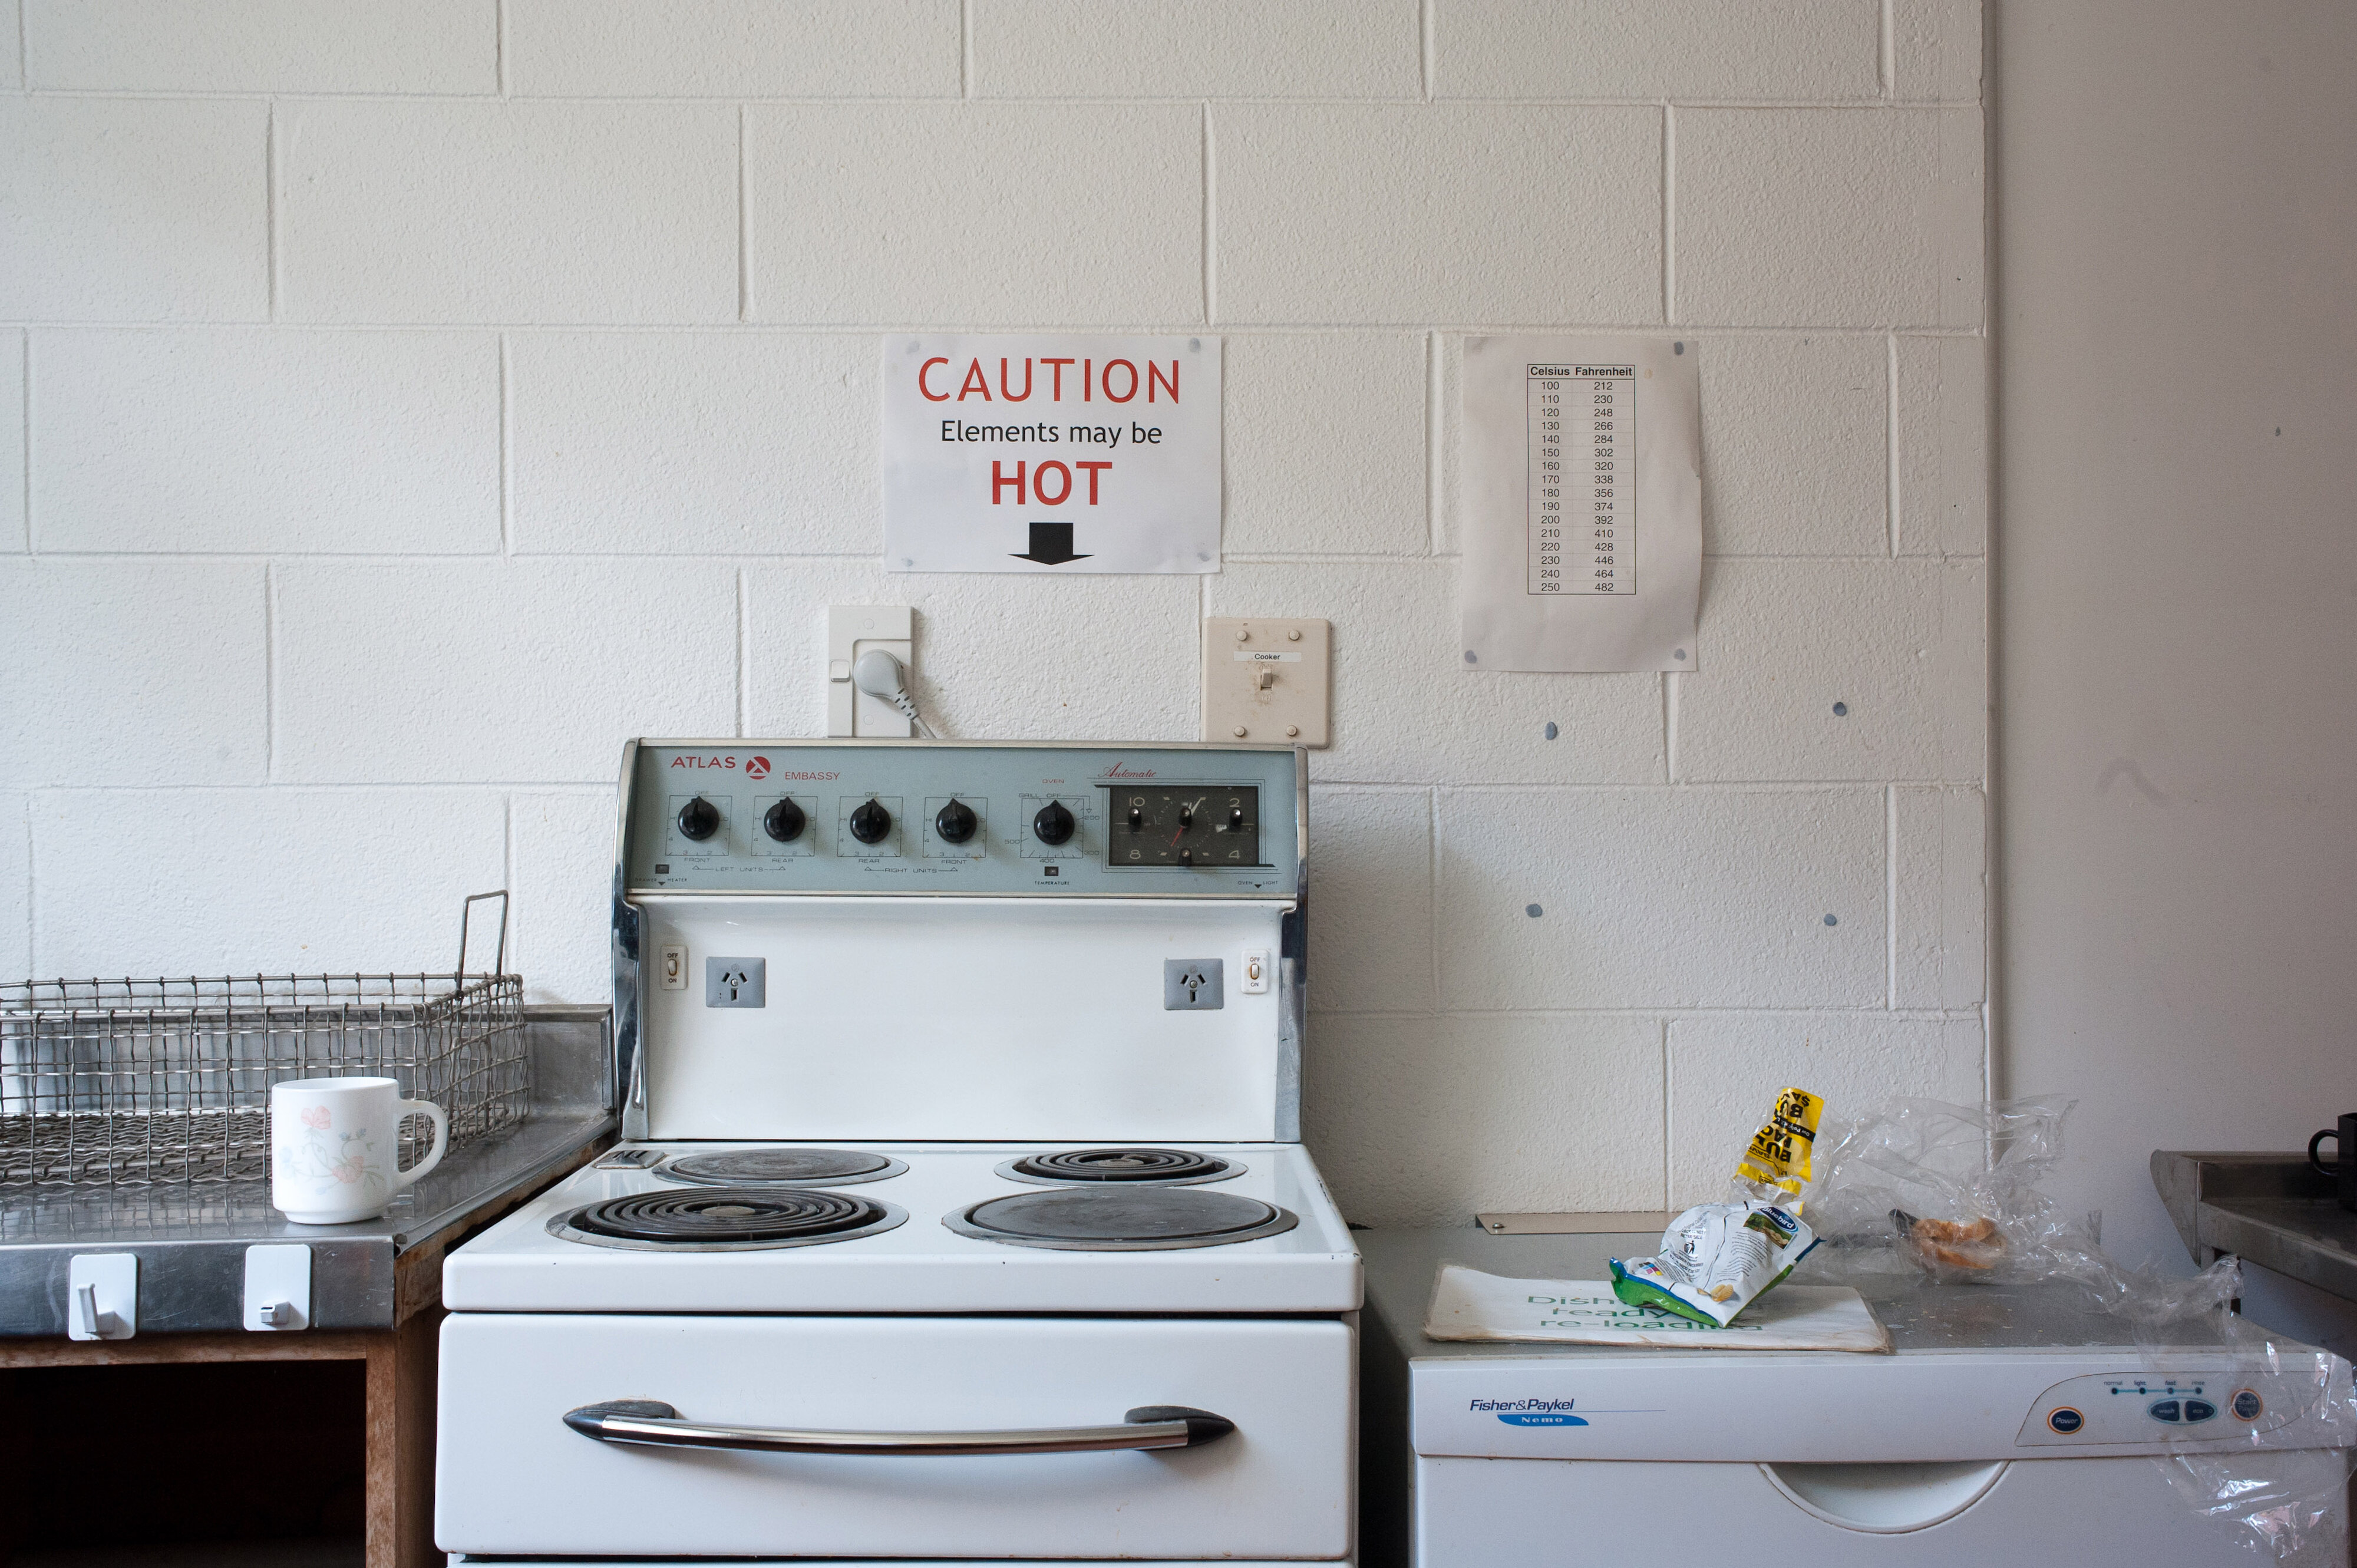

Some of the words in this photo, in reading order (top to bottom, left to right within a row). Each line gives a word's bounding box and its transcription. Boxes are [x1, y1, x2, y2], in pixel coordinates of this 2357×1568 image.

[1530, 367, 1570, 376] Celsius
[1575, 367, 1632, 377] Fahrenheit
[919, 357, 1178, 404] CAUTION
[1541, 381, 1560, 390] 100
[1594, 381, 1613, 390] 212
[1541, 394, 1560, 404] 110
[1594, 395, 1613, 404] 230
[1541, 408, 1560, 417] 120
[1594, 408, 1613, 417] 248
[1541, 421, 1560, 430] 130
[1594, 421, 1613, 431] 266
[942, 420, 1059, 443] Elements
[1069, 425, 1122, 448] may
[1131, 421, 1163, 444] be
[1542, 434, 1560, 444] 140
[1594, 435, 1613, 444] 284
[1542, 448, 1560, 457] 150
[1595, 448, 1613, 457] 302
[1542, 461, 1560, 470] 160
[1595, 461, 1614, 471] 320
[992, 460, 1113, 506] HOT
[1542, 475, 1560, 484] 170
[1594, 475, 1613, 484] 338
[1542, 488, 1560, 497] 180
[1594, 488, 1613, 498] 356
[1542, 501, 1560, 511] 190
[1595, 502, 1613, 511] 374
[1541, 515, 1560, 524] 200
[1595, 516, 1613, 524] 392
[1541, 529, 1560, 538] 210
[1595, 529, 1613, 538] 410
[1541, 542, 1560, 552] 220
[1595, 542, 1613, 552] 428
[1541, 556, 1560, 565] 230
[1595, 556, 1614, 565] 446
[1541, 569, 1560, 578] 240
[1595, 569, 1614, 579] 464
[1541, 582, 1560, 592] 250
[1595, 583, 1614, 592] 482
[671, 756, 736, 768] ATLAS
[1098, 761, 1157, 778] Automatic
[785, 771, 840, 780] EMBASSY
[1129, 796, 1146, 807] 10
[1229, 798, 1240, 807] 2
[1130, 849, 1141, 860] 8
[1229, 850, 1240, 860] 4
[1762, 1125, 1793, 1148] PAC
[1755, 1134, 1792, 1163] BUL
[1762, 1207, 1795, 1229] Bluebird
[1552, 1307, 1671, 1319] ready
[1540, 1319, 1762, 1331] re-loadi
[1470, 1398, 1574, 1413] Fisher&Paykel
